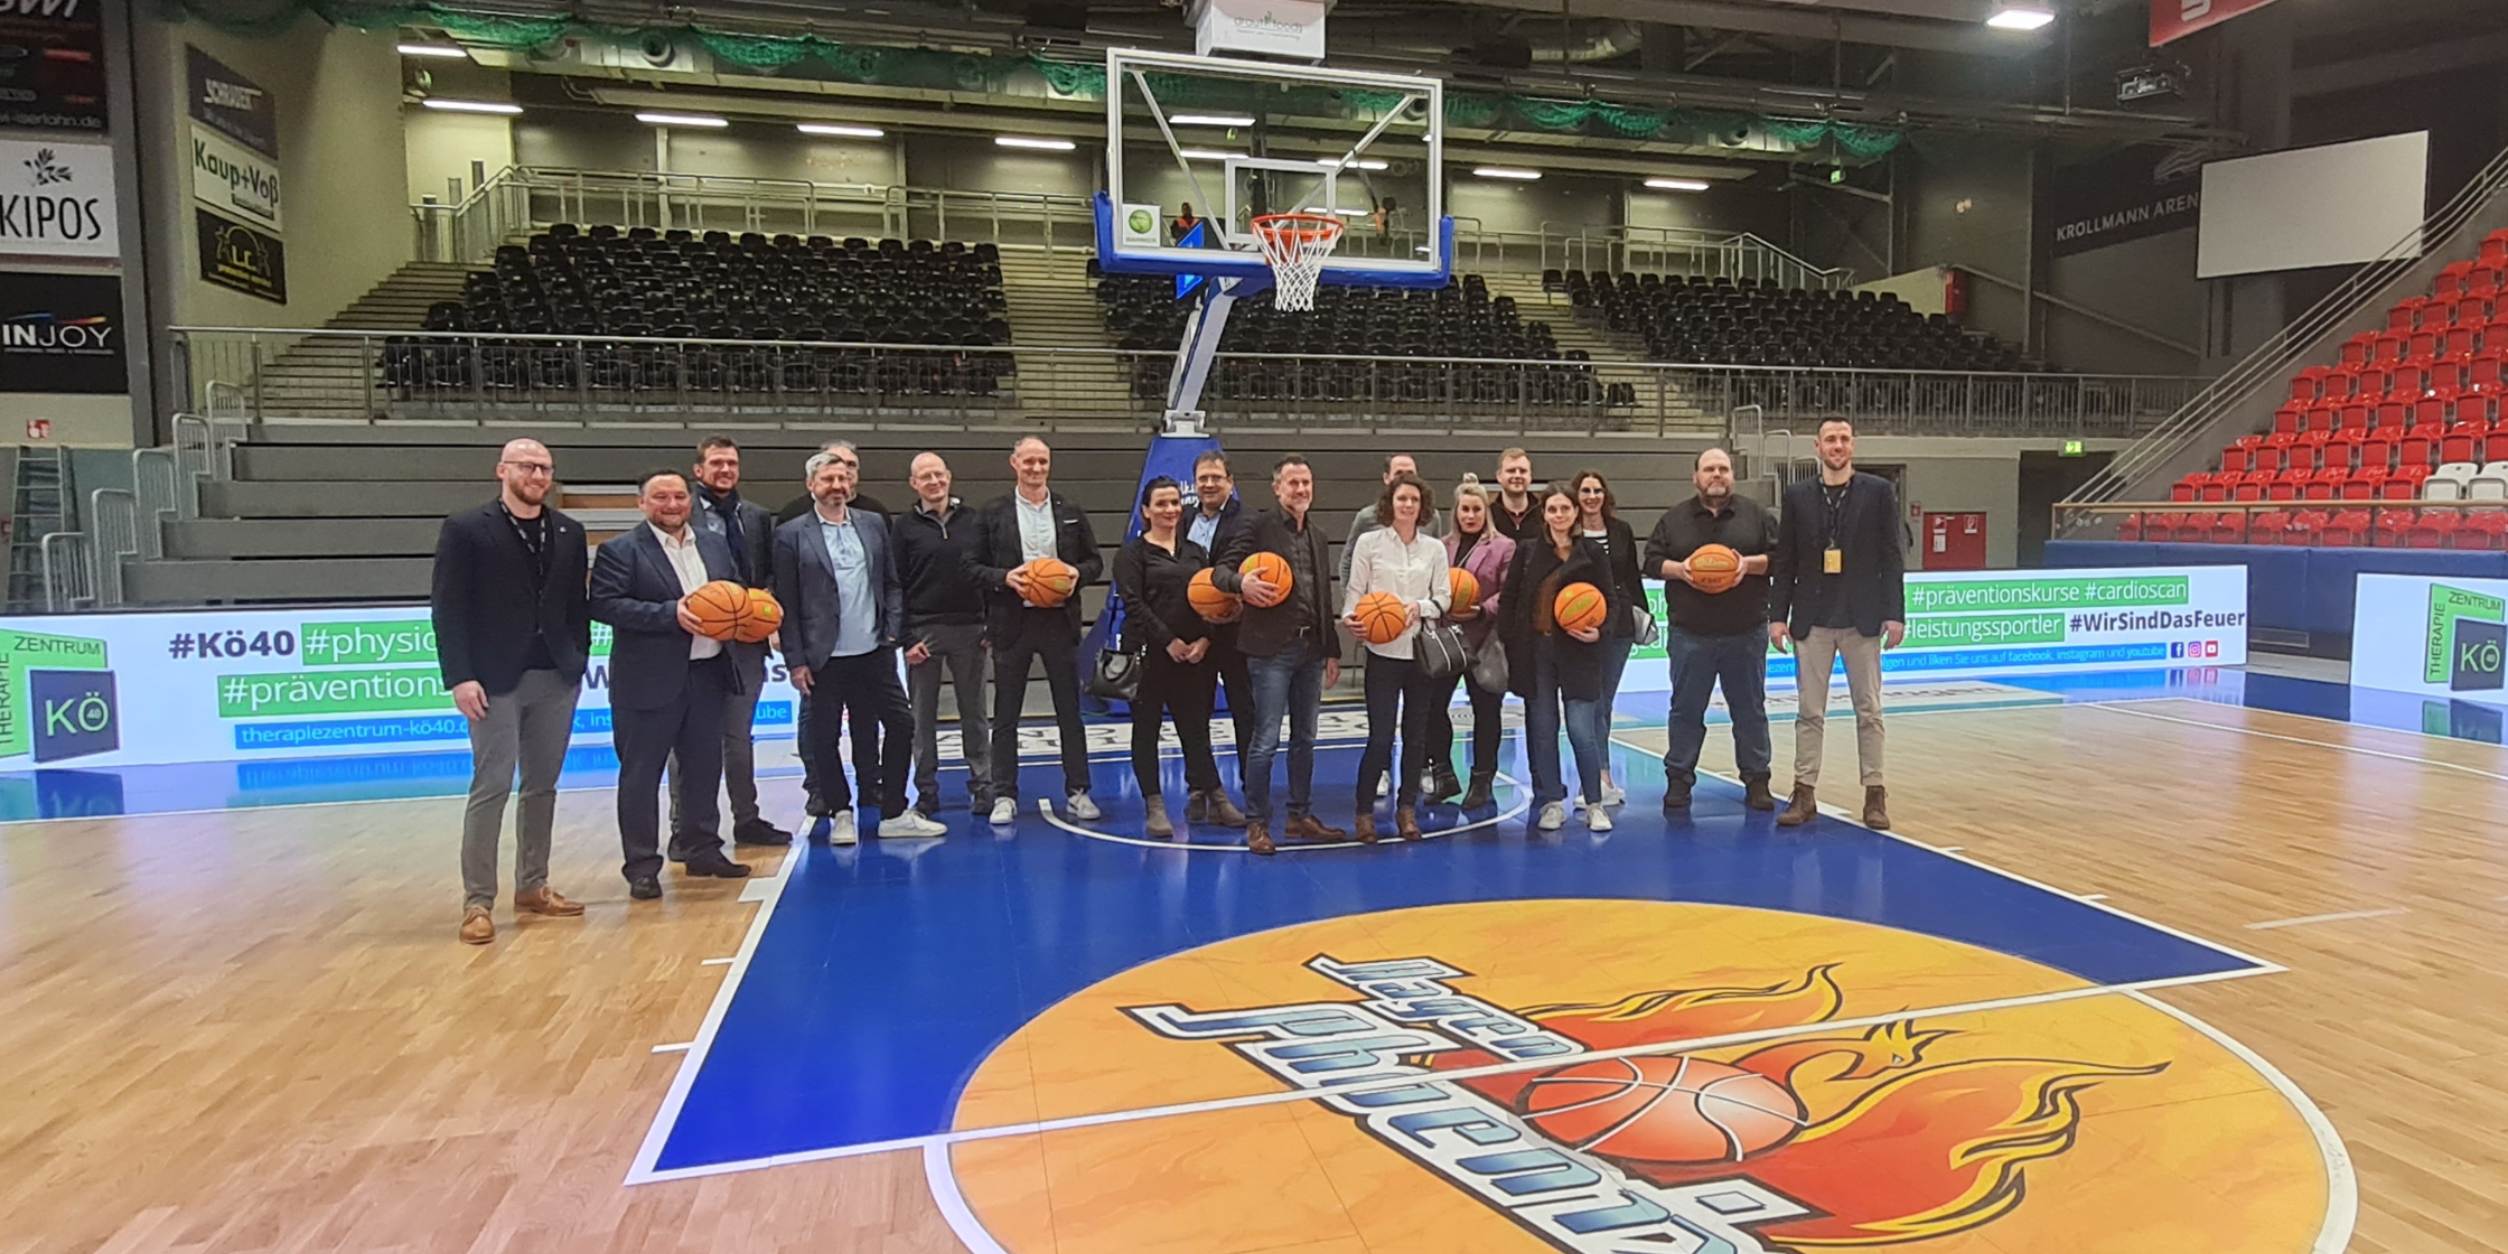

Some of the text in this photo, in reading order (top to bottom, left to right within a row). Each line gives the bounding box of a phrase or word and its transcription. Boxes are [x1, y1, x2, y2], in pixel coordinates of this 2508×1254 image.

[0, 194, 102, 240] KIPOS
[2056, 192, 2199, 241] KROLLMANN AREN
[3, 324, 112, 347] INJOY
[1912, 580, 2187, 611] #präventionskurse #cardioscan
[2449, 591, 2501, 611] ZENTRUM
[1904, 610, 2245, 642] #leistungssportler #WirSindDasFeuer
[2430, 602, 2446, 676] THERAPIE
[14, 636, 101, 655] ZENTRUM
[168, 629, 296, 659] #Kö40
[2460, 640, 2501, 672] KÖ
[1882, 657, 1905, 670] lgen
[45, 691, 109, 736] KÖ
